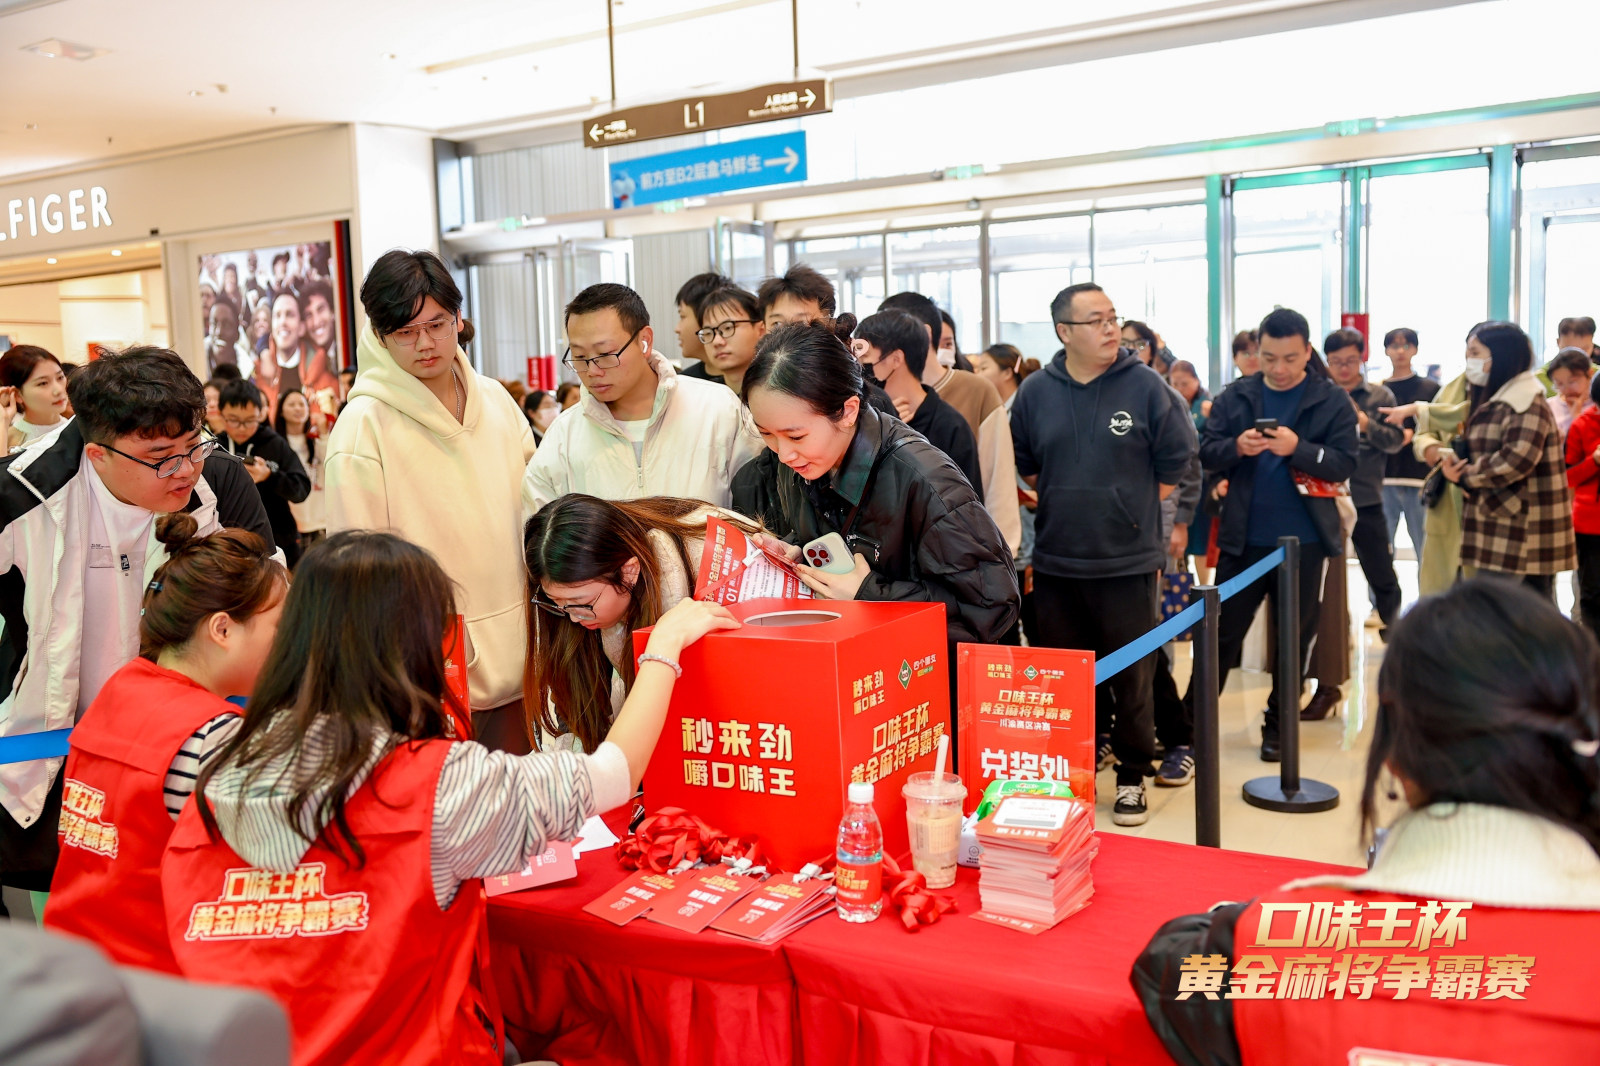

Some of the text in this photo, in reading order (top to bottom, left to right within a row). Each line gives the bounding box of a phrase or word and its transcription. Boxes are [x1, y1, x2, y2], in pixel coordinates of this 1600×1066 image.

[683, 101, 705, 129] L1
[853, 669, 884, 699] 秒来劲
[853, 690, 885, 715] 嚼口味王
[998, 689, 1055, 706] 口味王杯
[872, 701, 931, 754] 口味王杯
[979, 701, 1073, 722] 黄金麻将争霸赛
[681, 717, 793, 762] 秒来劲
[850, 721, 947, 784] 黄金麻将争霸赛
[683, 759, 797, 797] 嚼口味王
[980, 747, 1071, 787] 兑奖处
[224, 866, 322, 902] 口味王杯
[189, 897, 364, 937] 黄金麻将争霸赛
